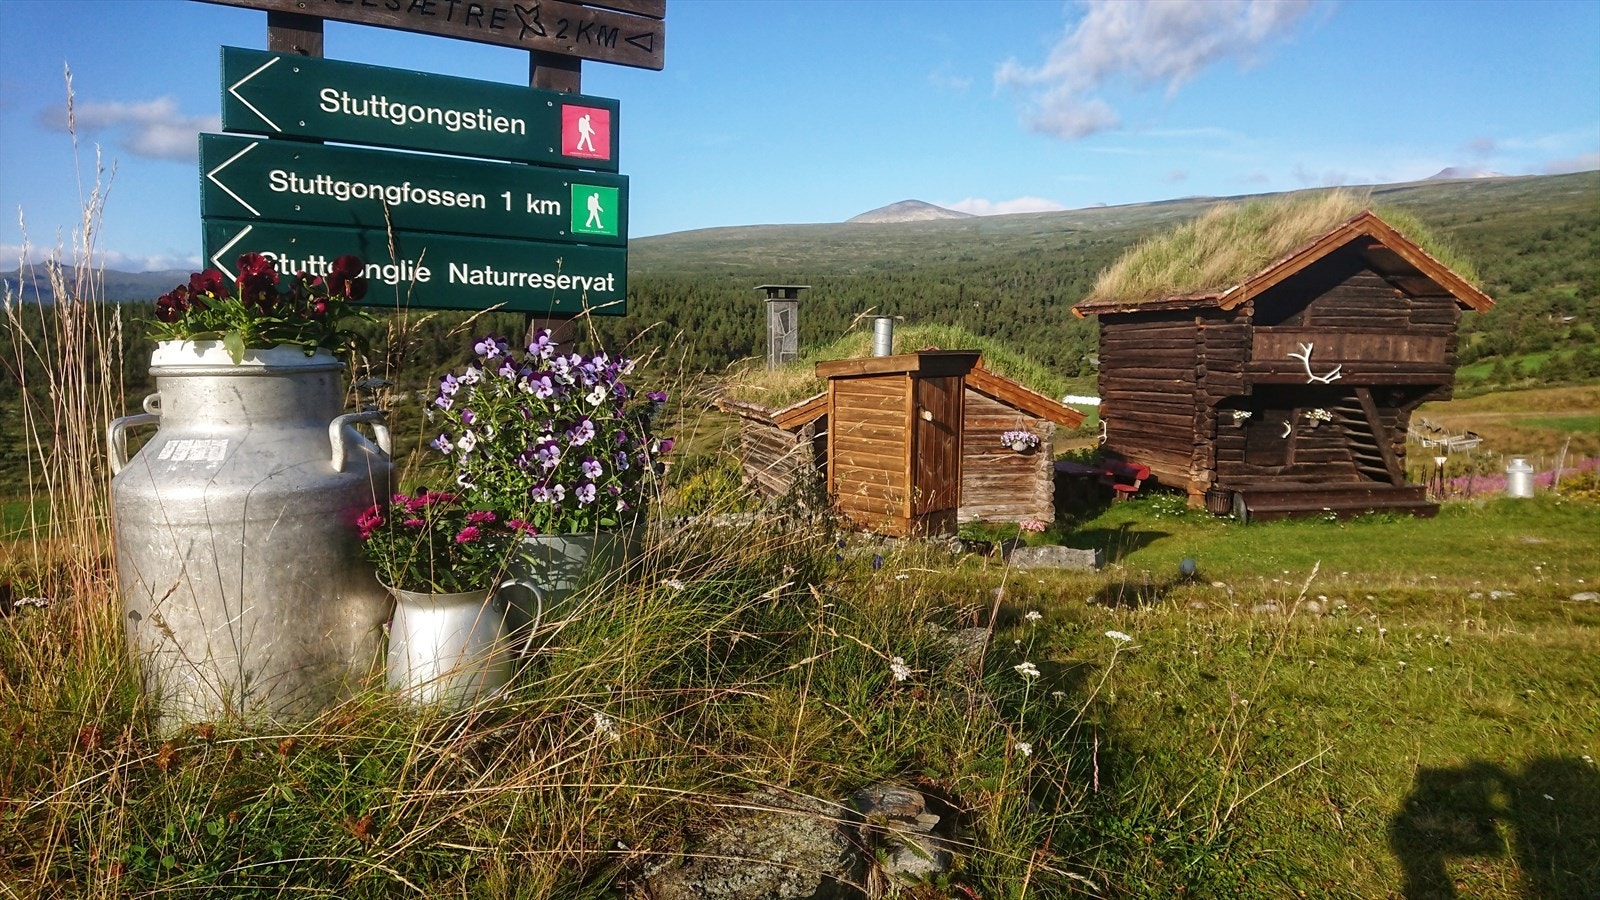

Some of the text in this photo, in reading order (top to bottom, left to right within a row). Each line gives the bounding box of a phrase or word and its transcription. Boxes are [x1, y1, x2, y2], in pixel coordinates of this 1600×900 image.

[319, 87, 526, 135] Stuttgongstien
[268, 169, 561, 216] Stuttgongfossen 1 km
[448, 262, 615, 292] Naturreservat
